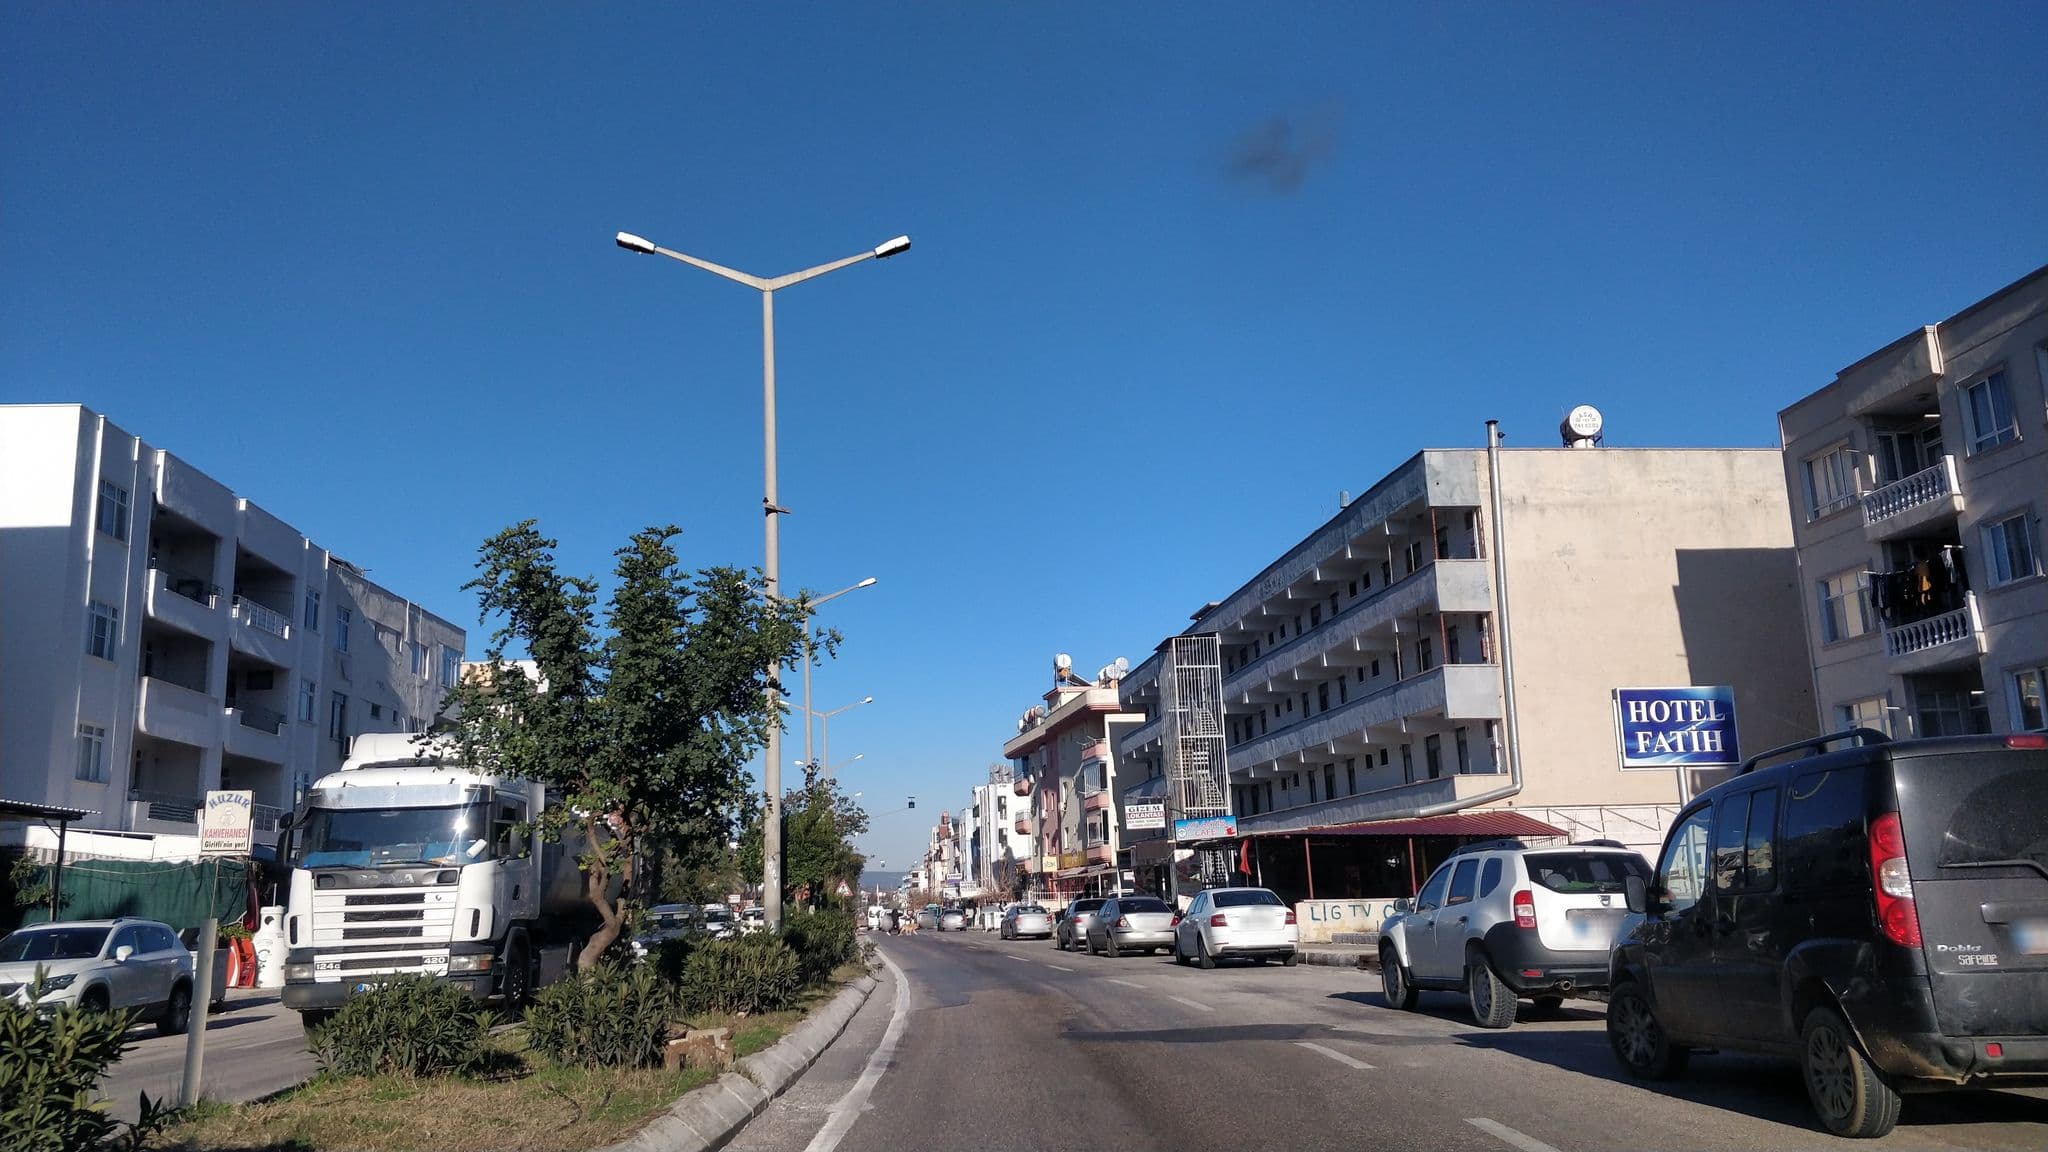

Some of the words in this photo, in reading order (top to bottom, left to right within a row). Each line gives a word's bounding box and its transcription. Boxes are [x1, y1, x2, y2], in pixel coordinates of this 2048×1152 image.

[1627, 700, 1726, 722] HOTEL
[1635, 725, 1726, 753] FATİH
[208, 794, 250, 809] HUZUR
[1348, 903, 1372, 917] TV
